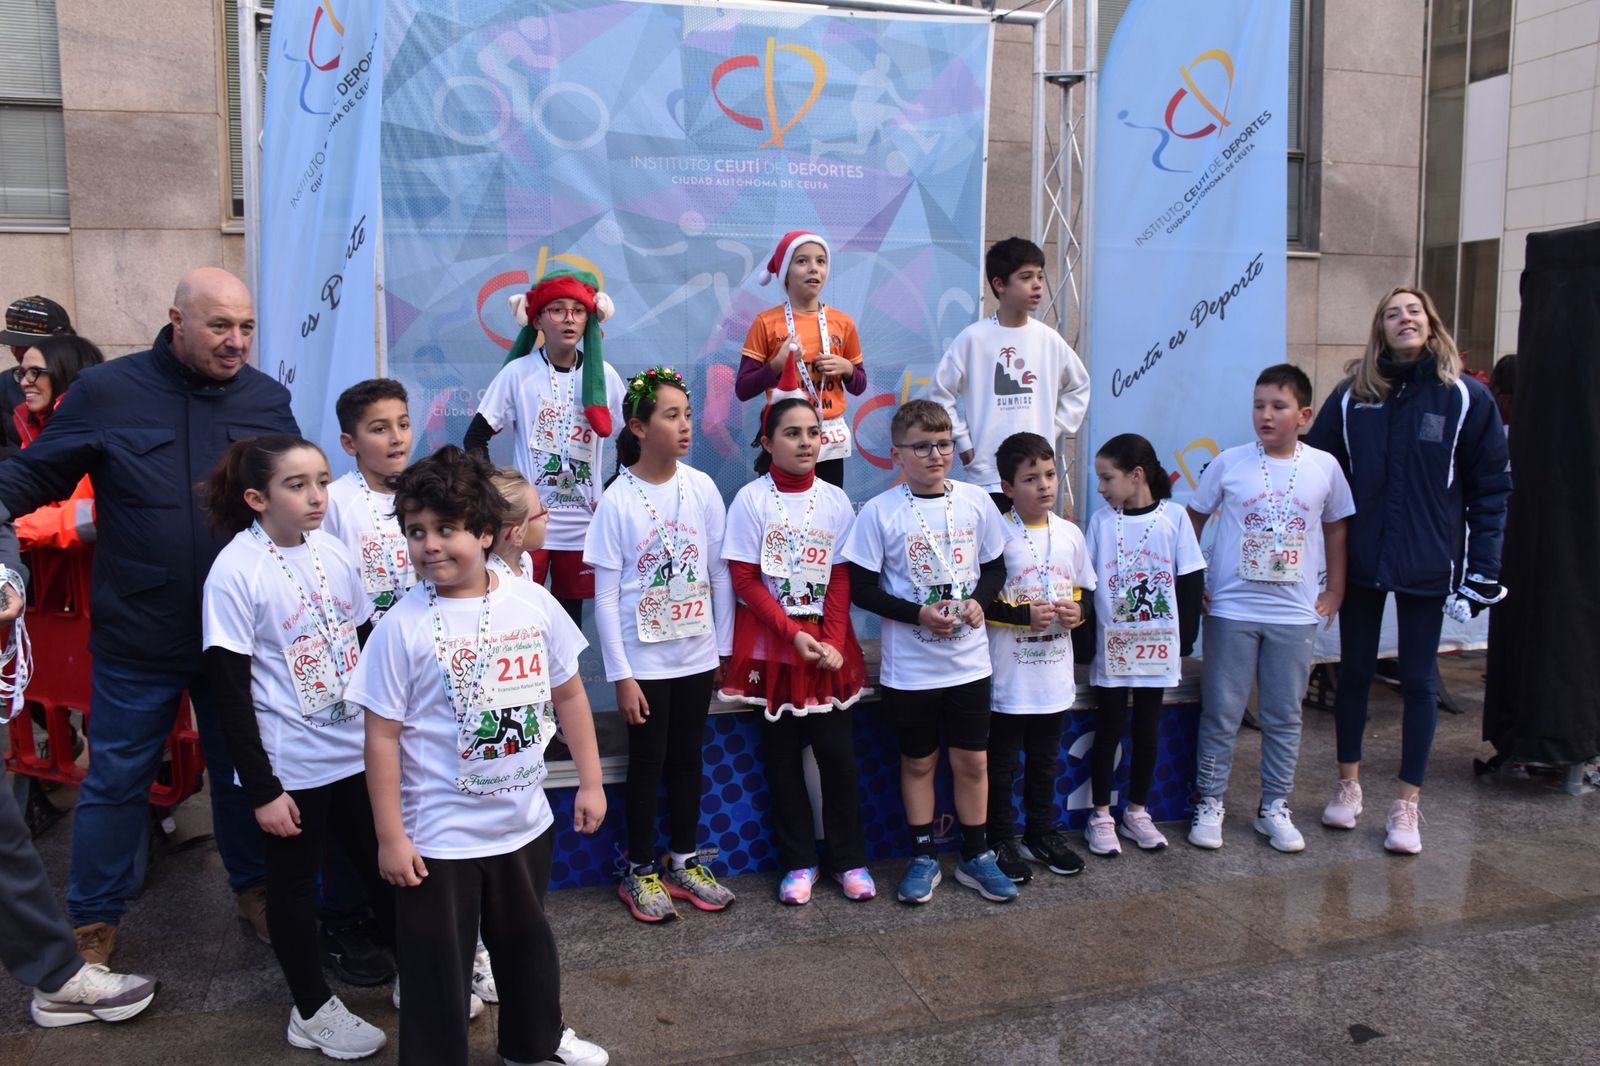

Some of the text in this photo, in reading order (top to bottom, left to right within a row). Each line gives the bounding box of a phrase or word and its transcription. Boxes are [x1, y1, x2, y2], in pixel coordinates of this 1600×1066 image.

[630, 156, 711, 173] INSTITUTO
[764, 161, 785, 176] DE
[788, 162, 864, 178] DEPORTES
[291, 151, 326, 209] INSTITUTO
[671, 175, 714, 186] CIUDAD
[780, 179, 795, 189] DE
[797, 180, 829, 190] CEUTA
[1134, 201, 1184, 247] INSTITUTO
[1208, 157, 1225, 175] DE
[1221, 110, 1272, 160] DEPORTES
[1166, 209, 1192, 235] CIUDAD
[1225, 163, 1235, 175] DE
[1233, 143, 1256, 165] CEUTA
[301, 312, 320, 338] es
[1111, 252, 1264, 397] Ceuta es Deporte
[997, 396, 1032, 406] SUNRISE
[820, 429, 847, 446] 615
[671, 600, 704, 621] 372
[1135, 644, 1169, 660] 278
[497, 653, 542, 682] 214
[466, 773, 511, 787] Francisco
